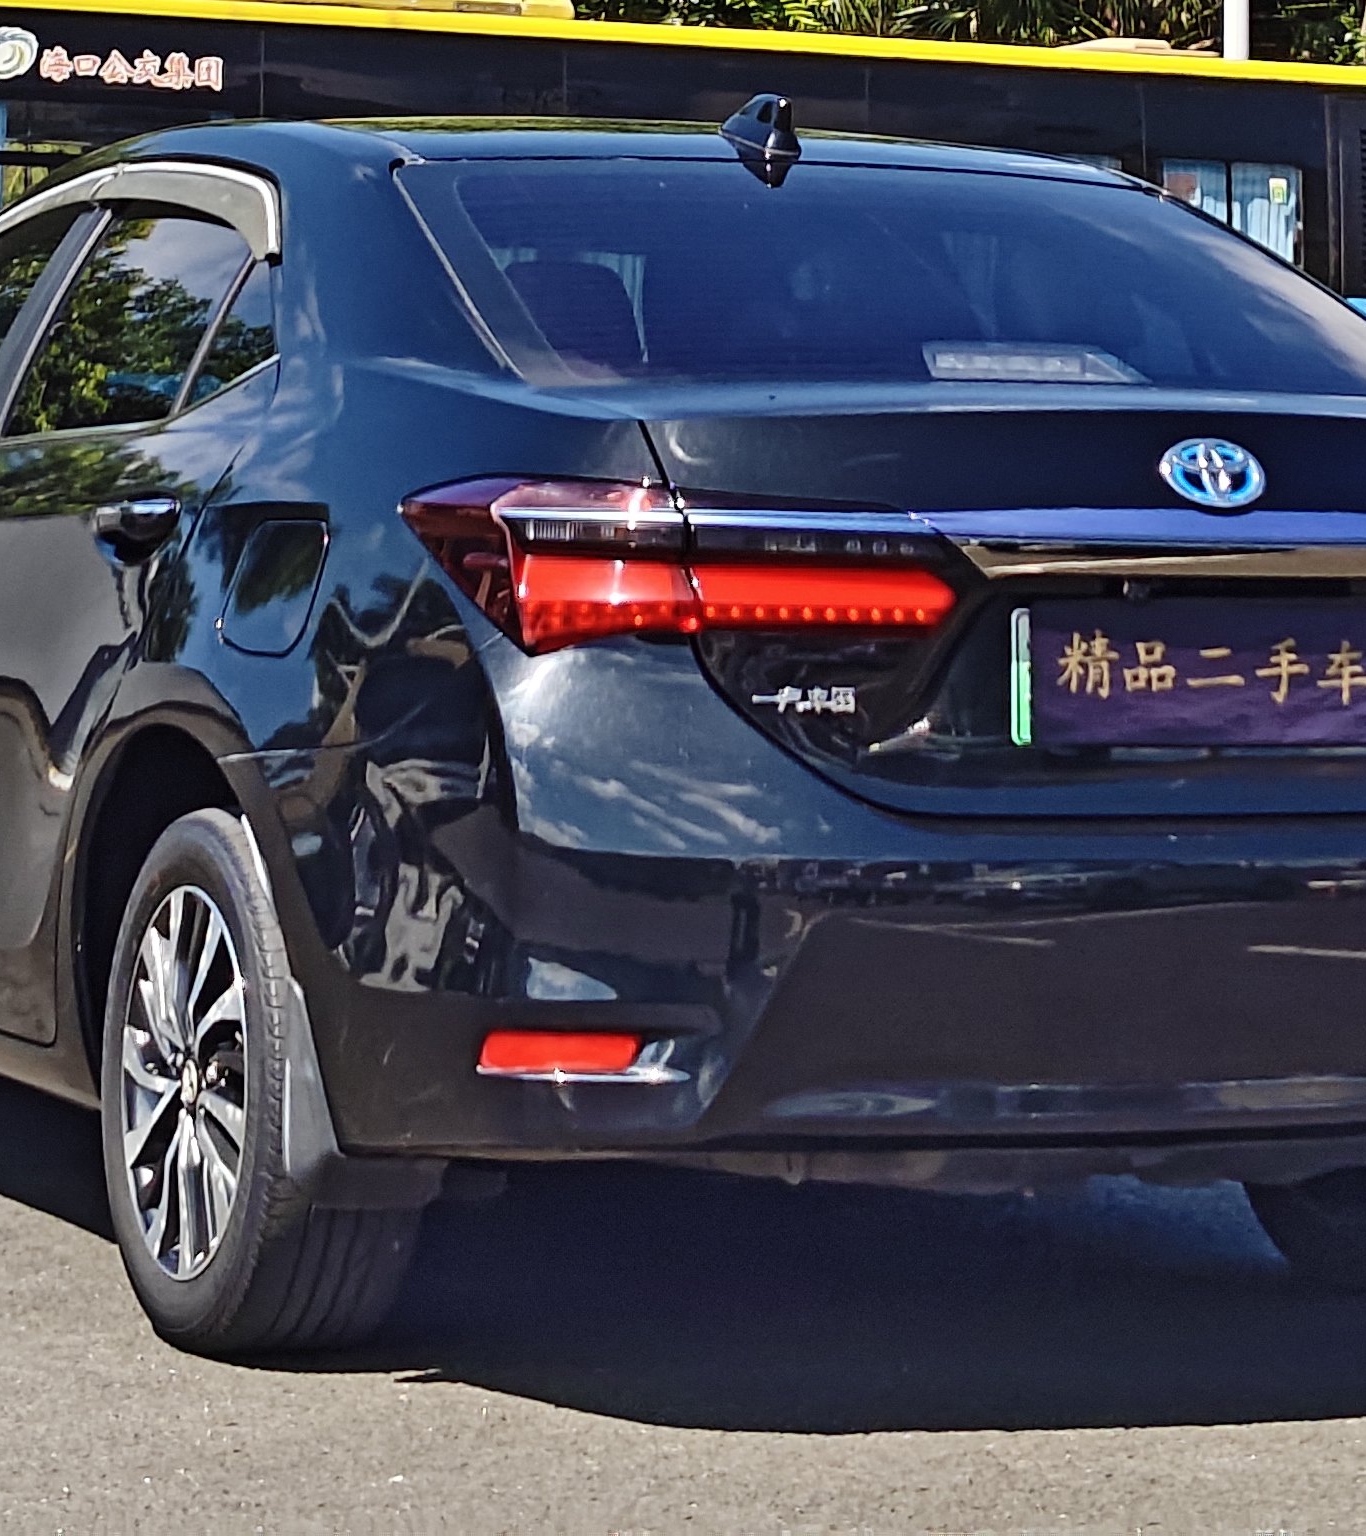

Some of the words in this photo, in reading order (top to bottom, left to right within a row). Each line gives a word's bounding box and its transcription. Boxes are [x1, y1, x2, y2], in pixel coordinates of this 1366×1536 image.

[39, 45, 224, 92] 海口公交集团
